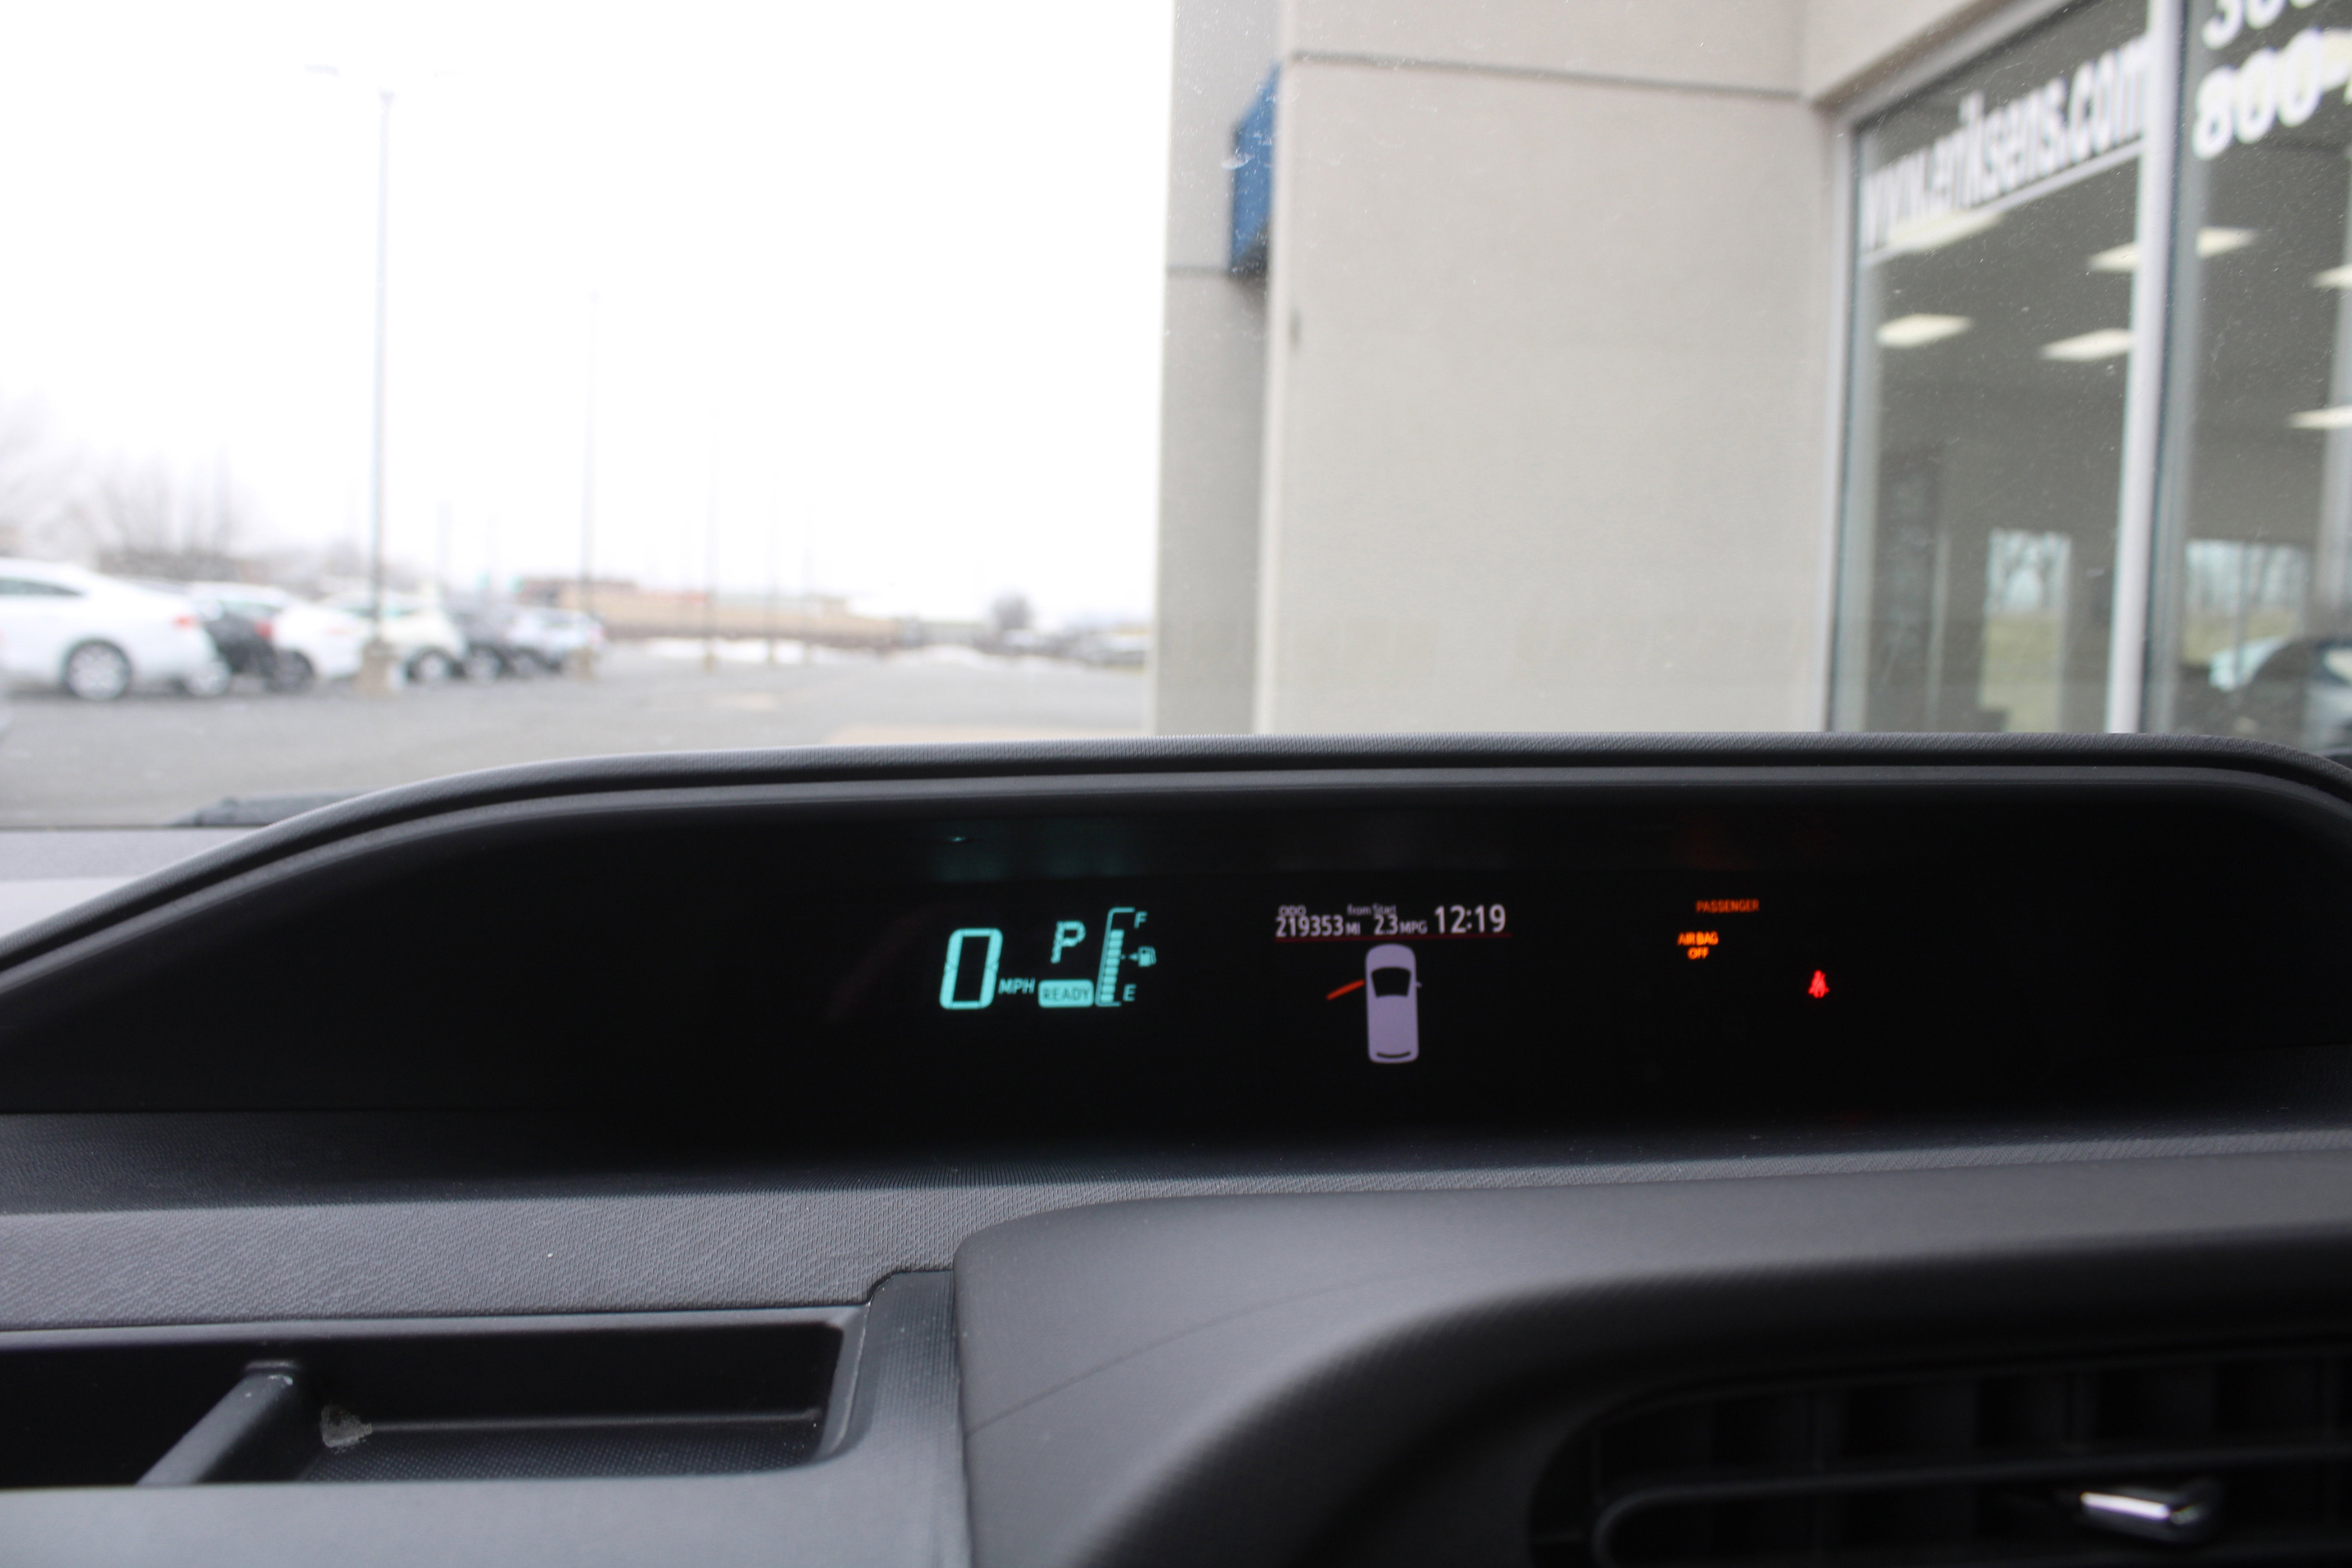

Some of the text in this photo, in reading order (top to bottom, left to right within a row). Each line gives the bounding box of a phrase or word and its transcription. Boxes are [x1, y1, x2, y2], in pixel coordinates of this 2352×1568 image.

[1278, 905, 1306, 916] ODO
[1696, 899, 1759, 913] PASSENGER
[1134, 911, 1147, 928] F
[1276, 915, 1343, 936] 219353
[1434, 904, 1505, 933] 12:19
[1399, 920, 1428, 934] MPG
[1051, 921, 1085, 963] P
[1688, 947, 1709, 959] OFF
[940, 928, 1003, 1009] 0
[998, 978, 1036, 994] MPH
[1123, 983, 1136, 1002] E
[1042, 987, 1091, 1002] READY
